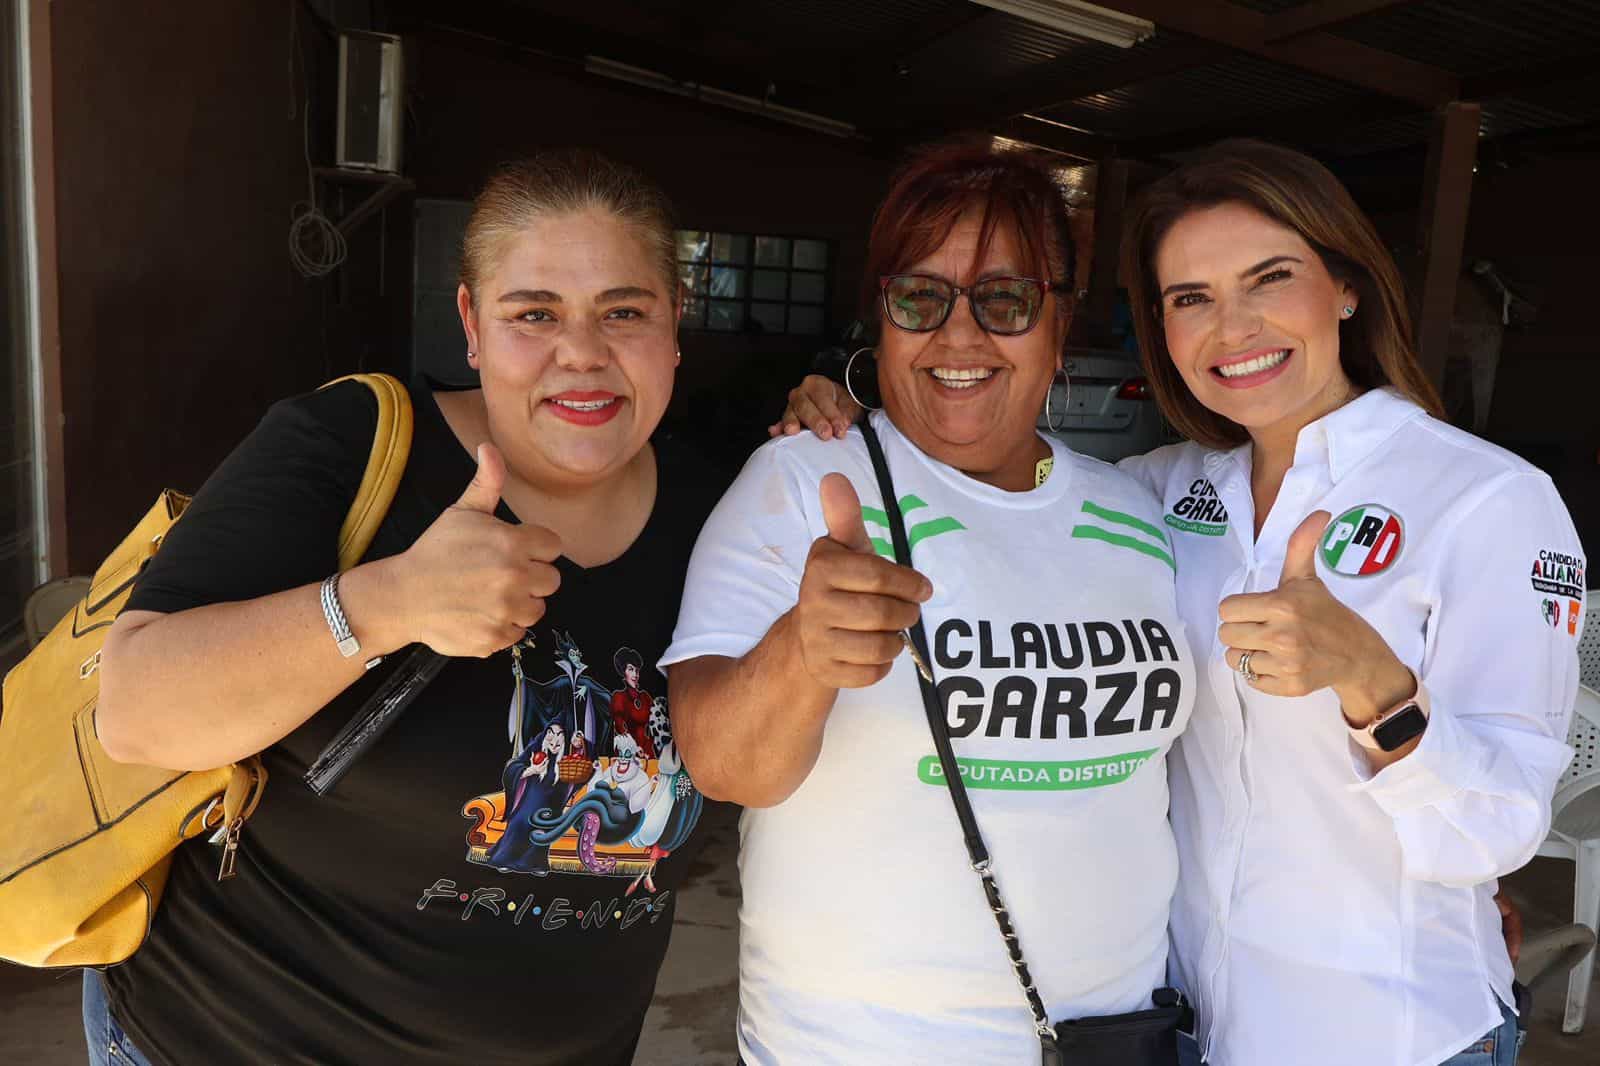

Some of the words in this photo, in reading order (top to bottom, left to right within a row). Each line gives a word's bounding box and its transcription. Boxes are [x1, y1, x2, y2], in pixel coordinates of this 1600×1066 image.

[1325, 515, 1397, 565] PRI
[1531, 559, 1583, 588] ALIANZ
[934, 618, 1179, 669] CLAUDIA
[936, 668, 1181, 739] GARZA
[928, 762, 1051, 783] DPUTADA
